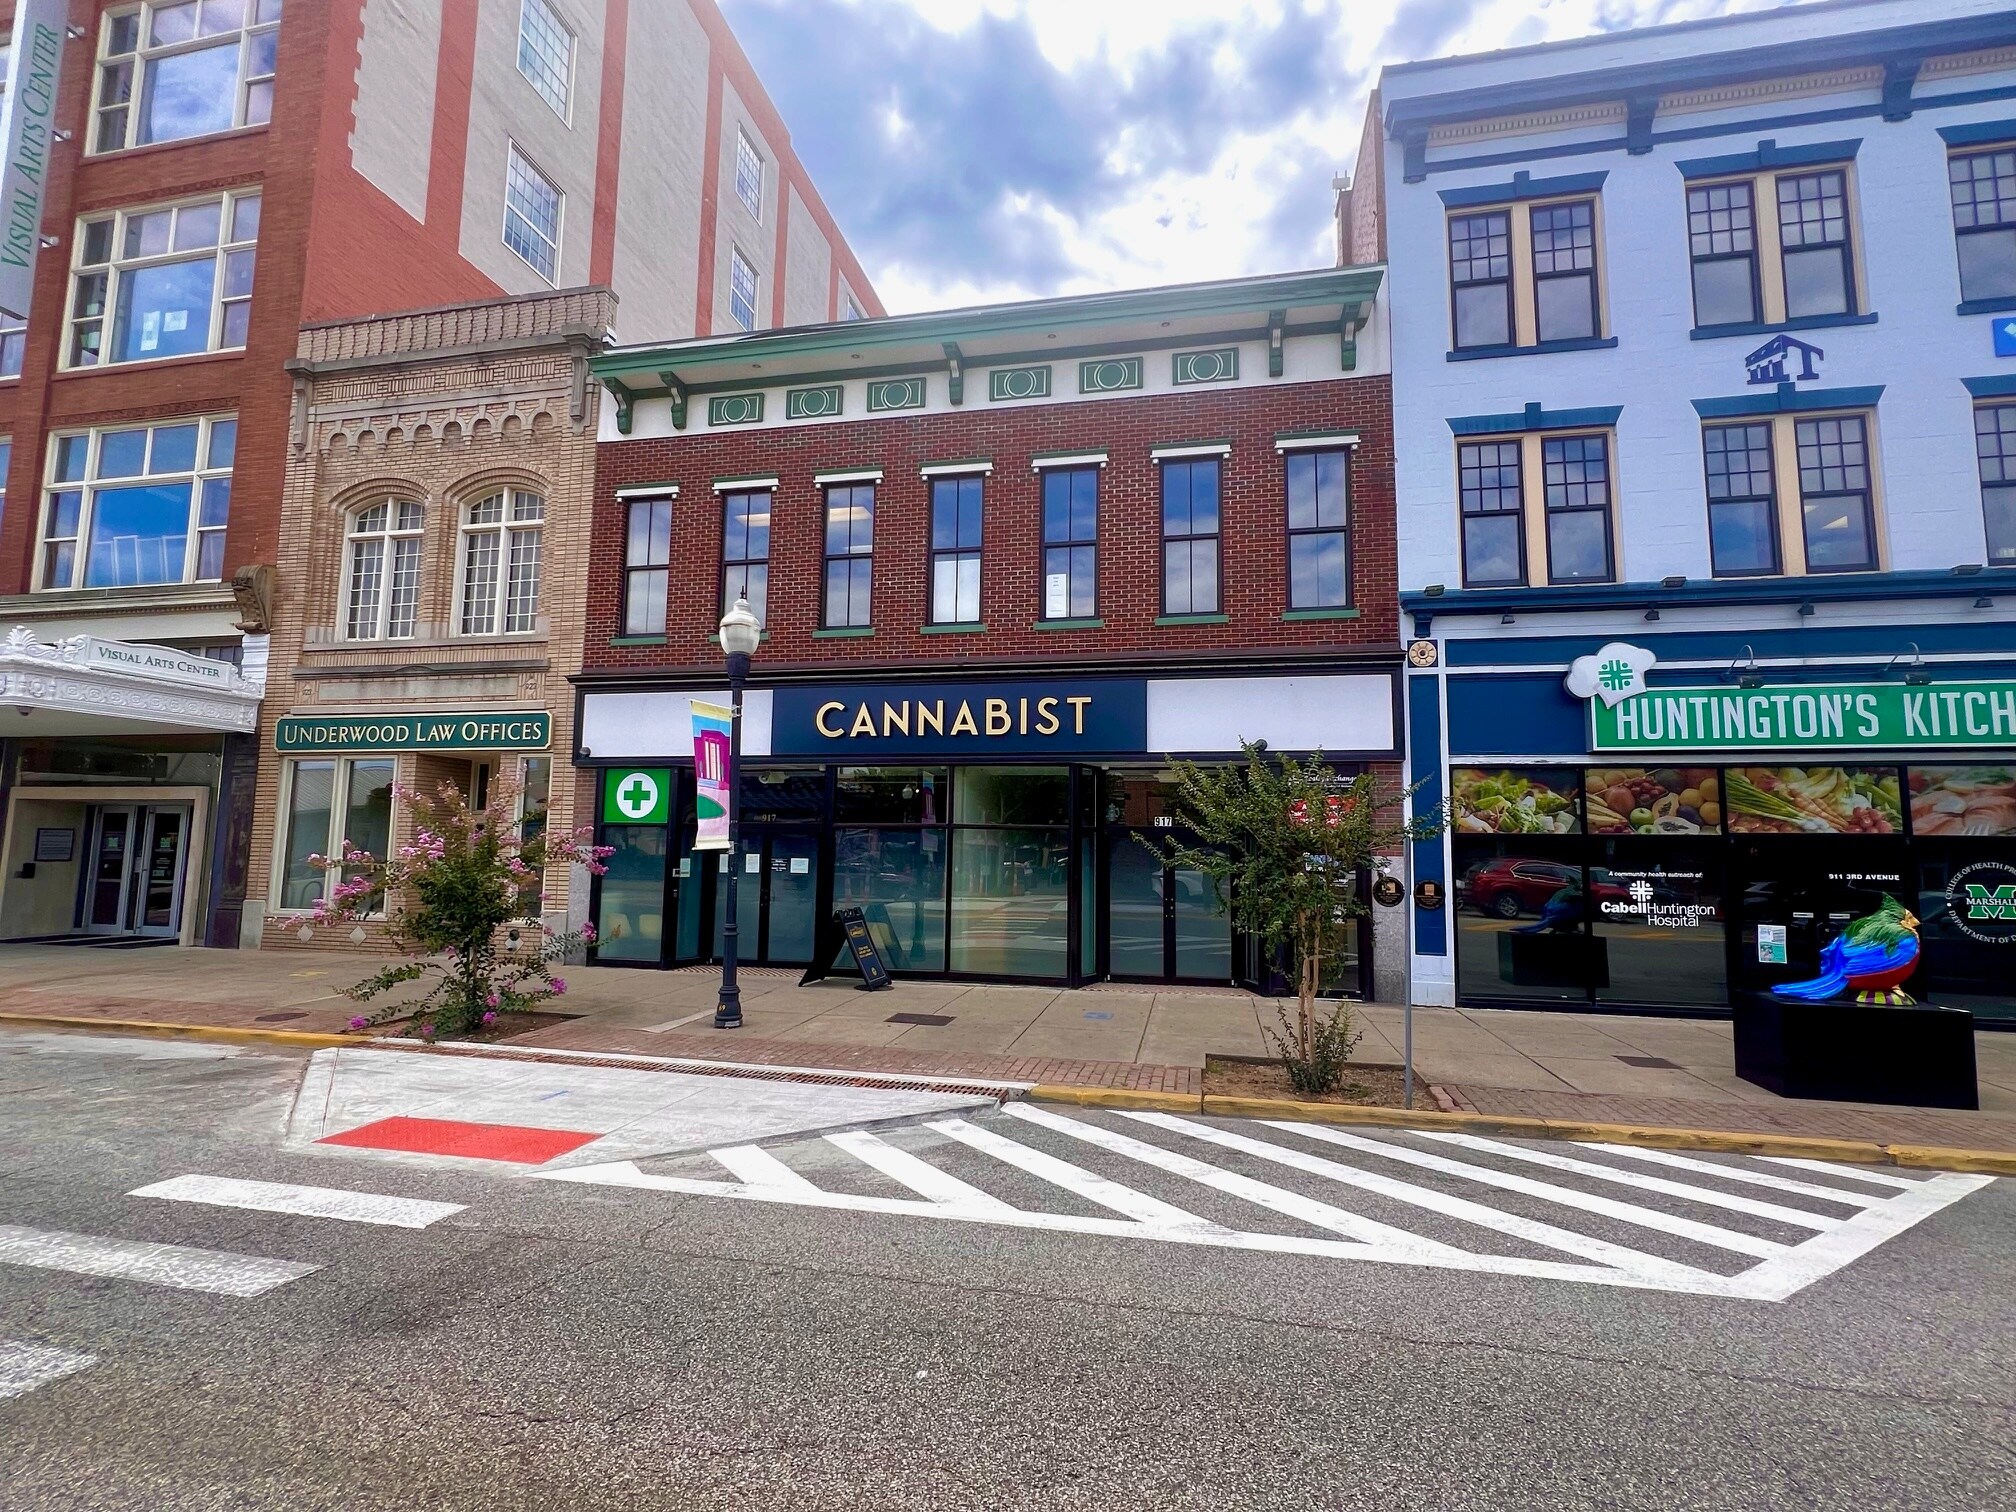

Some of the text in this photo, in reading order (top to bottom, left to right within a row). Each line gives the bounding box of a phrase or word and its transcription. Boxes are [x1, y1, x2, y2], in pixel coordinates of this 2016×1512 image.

[1, 23, 58, 268] VISUAL ARTS CENTER
[98, 646, 220, 677] VISUAL ARTS CENTER
[816, 697, 1092, 738] CANNABIST
[1616, 690, 2016, 740] HUNTINGTON'S KITCH
[284, 721, 542, 744] UNDERWOOD LAW OFFICES
[761, 813, 777, 822] 917
[1155, 817, 1172, 826] 917
[1944, 872, 1964, 900] COLLEGE
[1961, 866, 1972, 875] OF
[1971, 862, 2004, 871] HEALTH
[1600, 901, 1716, 917] Cabell Huntington
[1647, 914, 1700, 929] Hospital
[1948, 910, 1997, 943] DEPARTMENT
